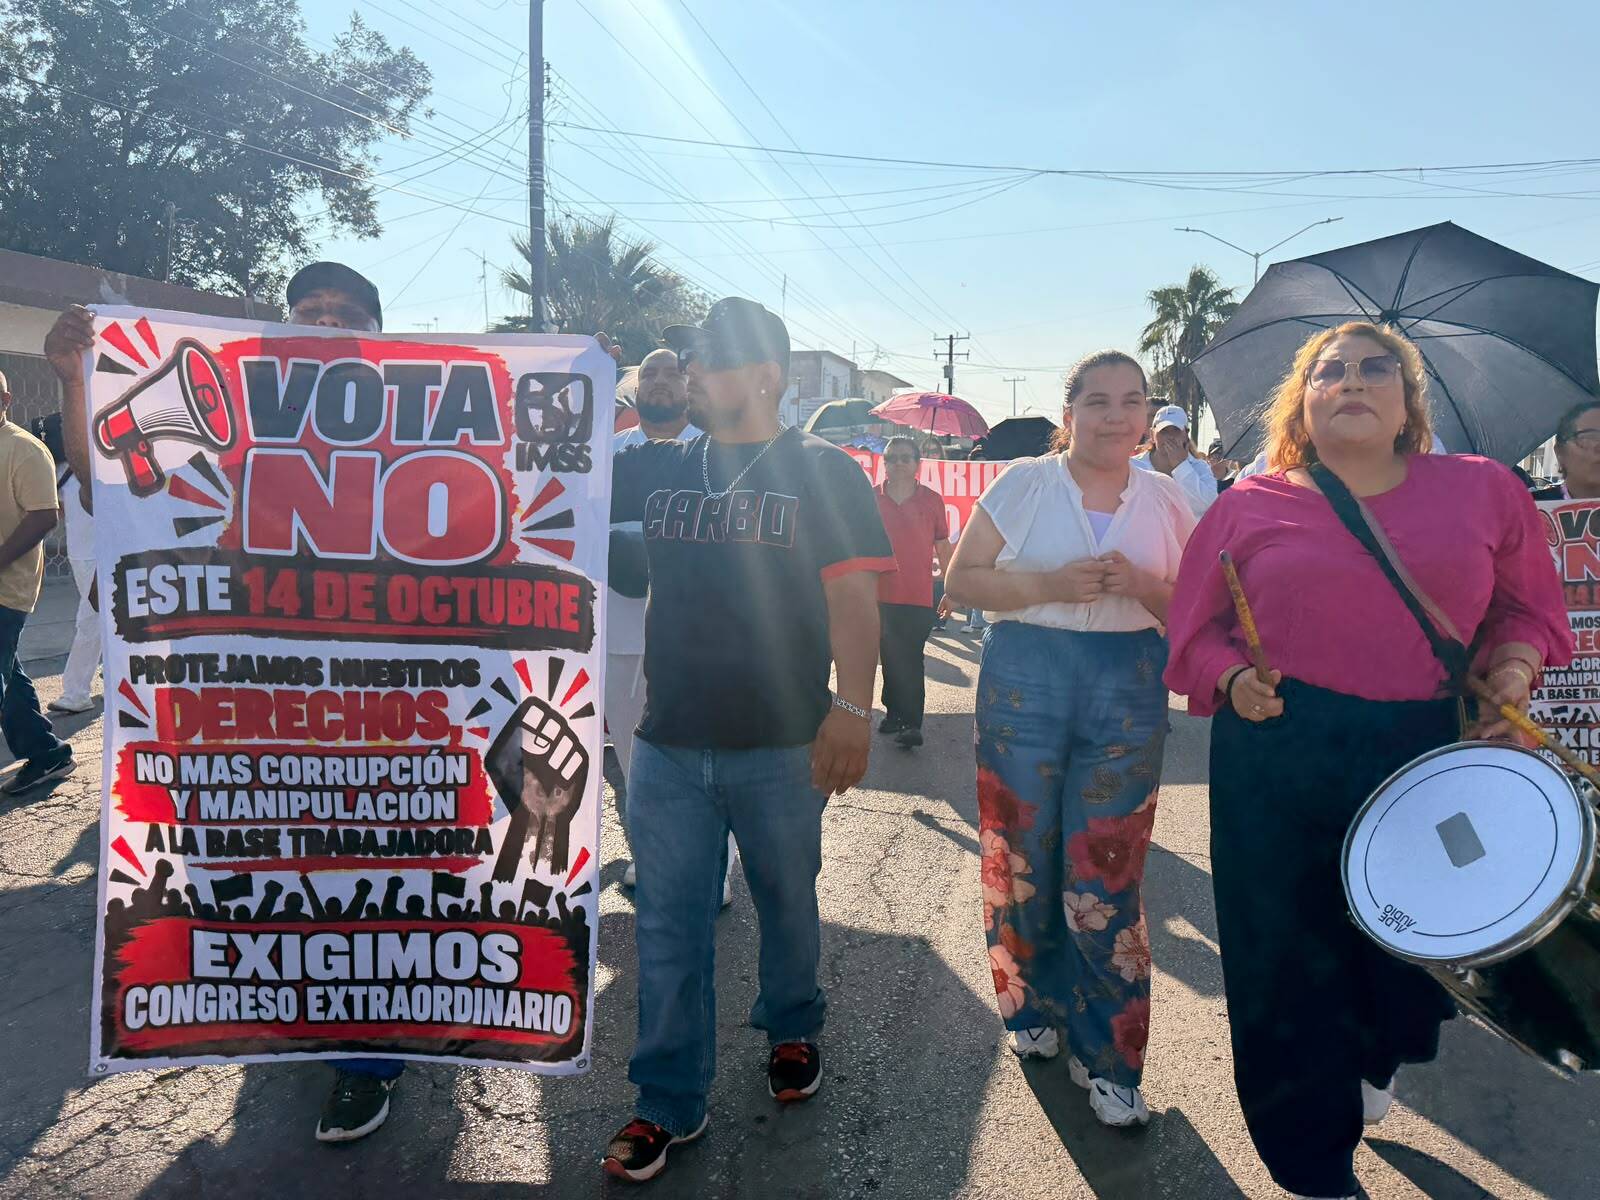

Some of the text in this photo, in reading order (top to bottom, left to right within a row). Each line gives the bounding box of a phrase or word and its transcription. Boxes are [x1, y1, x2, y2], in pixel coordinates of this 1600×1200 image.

[238, 356, 505, 447] VOTA
[516, 442, 593, 473] IMSS
[243, 447, 502, 566] NO
[126, 564, 580, 634] ESTE 14 DE OCTUBRE
[129, 653, 482, 688] PROTEJAMOS NUESTROS
[1548, 687, 1580, 700] BASE
[155, 687, 464, 748] DERECHOS,
[136, 749, 467, 786] NO MAS CORRUPCIÓN
[170, 785, 455, 821] Y MANIPULACIÓN
[145, 823, 494, 858] A LA BASE TRABAJADORA
[1378, 911, 1408, 934] ALDE
[1383, 904, 1417, 927] AUDIO
[193, 929, 519, 984] EXIGIMOS
[125, 983, 572, 1035] CONGRESO EXTRAORDINARIO
